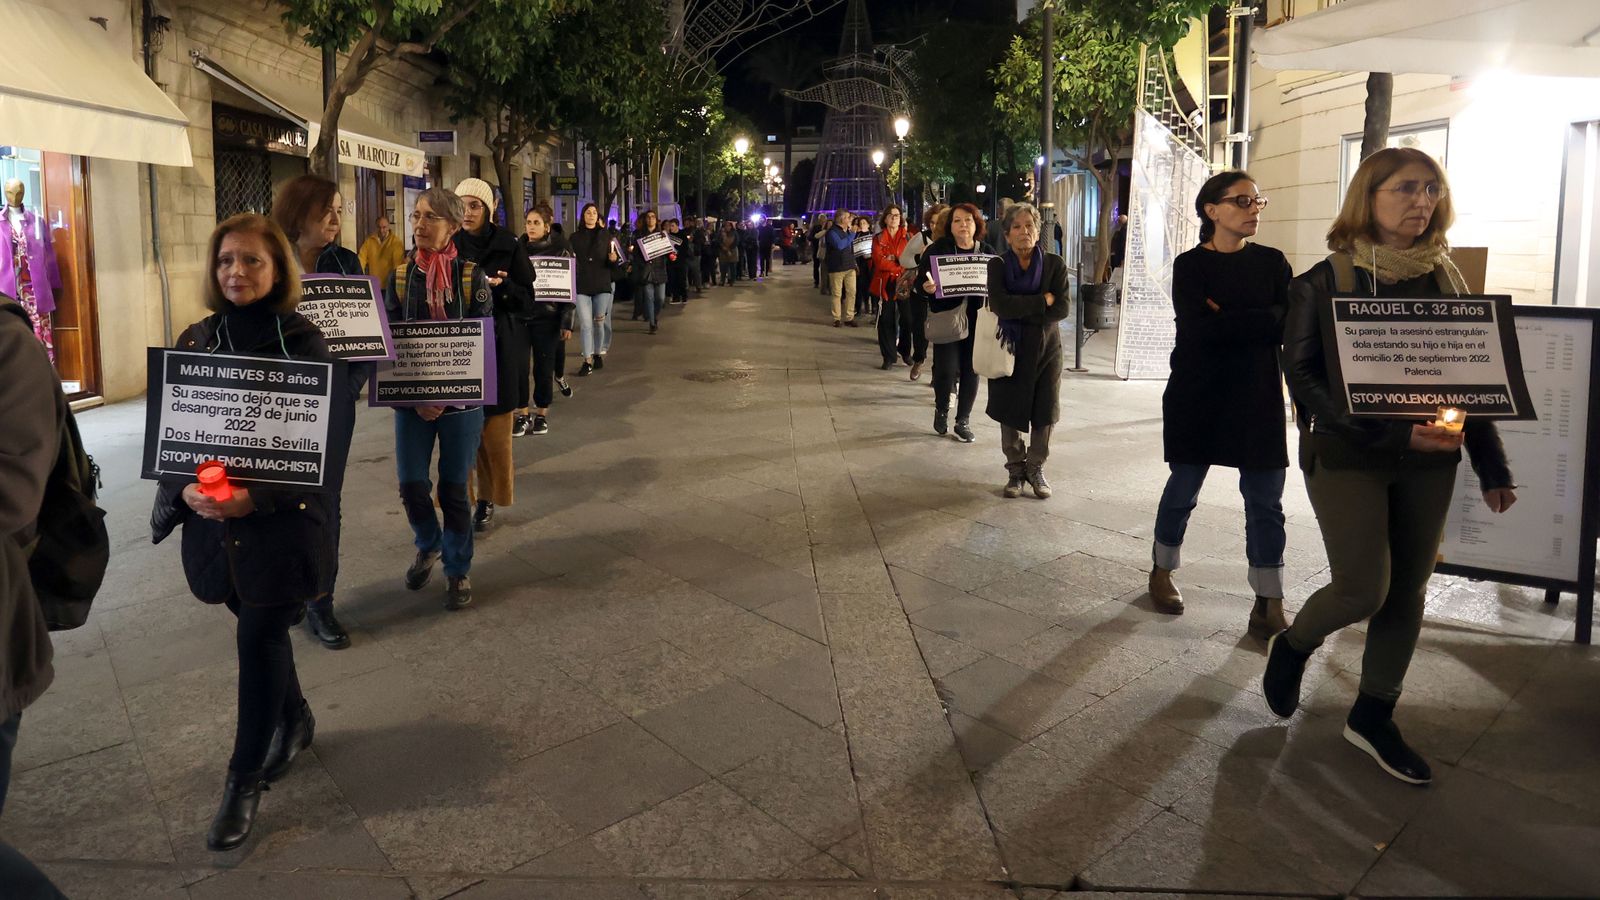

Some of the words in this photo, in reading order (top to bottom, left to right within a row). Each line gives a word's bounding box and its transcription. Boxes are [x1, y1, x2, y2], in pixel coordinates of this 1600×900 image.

[240, 120, 263, 137] CASA
[268, 126, 307, 147] MARQUEZ
[338, 140, 351, 157] SA
[357, 144, 400, 167] MARQUEZ
[328, 301, 356, 311] golpes
[1349, 303, 1410, 316] RAQUEL
[1413, 303, 1428, 315] C.
[1431, 303, 1449, 315] 32
[1452, 303, 1485, 316] años
[324, 310, 334, 318] 21
[350, 310, 369, 319] junio
[316, 319, 339, 328] 2022
[321, 329, 346, 337] evilla
[407, 327, 449, 336] SAADAQUI
[1345, 327, 1357, 336] Su
[1359, 328, 1386, 337] pareja
[1390, 327, 1398, 336] la
[1400, 328, 1433, 336] asesinó
[1434, 327, 1489, 337] estrangulán-
[346, 342, 384, 352] MACHISTA
[394, 341, 423, 350] uñalada
[450, 340, 476, 349] pareja.
[1352, 340, 1372, 349] dola
[1423, 340, 1439, 350] hijo
[1448, 340, 1463, 350] hija
[1477, 340, 1485, 349] el
[406, 350, 440, 358] huérfano
[1352, 354, 1392, 362] domicilio
[1393, 354, 1404, 362] 26
[1405, 354, 1417, 362] de
[1419, 354, 1468, 364] septiembre
[1469, 353, 1490, 362] 2022
[180, 364, 214, 378] MARI
[217, 367, 265, 382] NIEVES
[268, 371, 284, 383] 53
[287, 372, 319, 386] años
[1404, 367, 1442, 376] Palencia
[400, 386, 440, 395] VIOLENCIA
[441, 385, 481, 394] MACHISTA
[172, 386, 190, 398] Su
[191, 388, 239, 403] asesino
[242, 392, 272, 408] dejó
[275, 395, 300, 409] que
[303, 398, 319, 409] se
[1352, 393, 1384, 404] STOP
[1386, 393, 1444, 404] VIOLENCIA
[1446, 393, 1509, 405] MACHISTA
[171, 401, 242, 417] desangrara
[245, 406, 261, 418] 29
[264, 407, 282, 420] de
[284, 410, 318, 423] junio
[224, 419, 256, 432] 2022
[165, 427, 190, 441] Dos
[194, 430, 267, 448] Hermanas
[271, 436, 319, 451] Sevilla
[161, 450, 192, 463] STOP
[255, 459, 319, 474] MACHISTA
